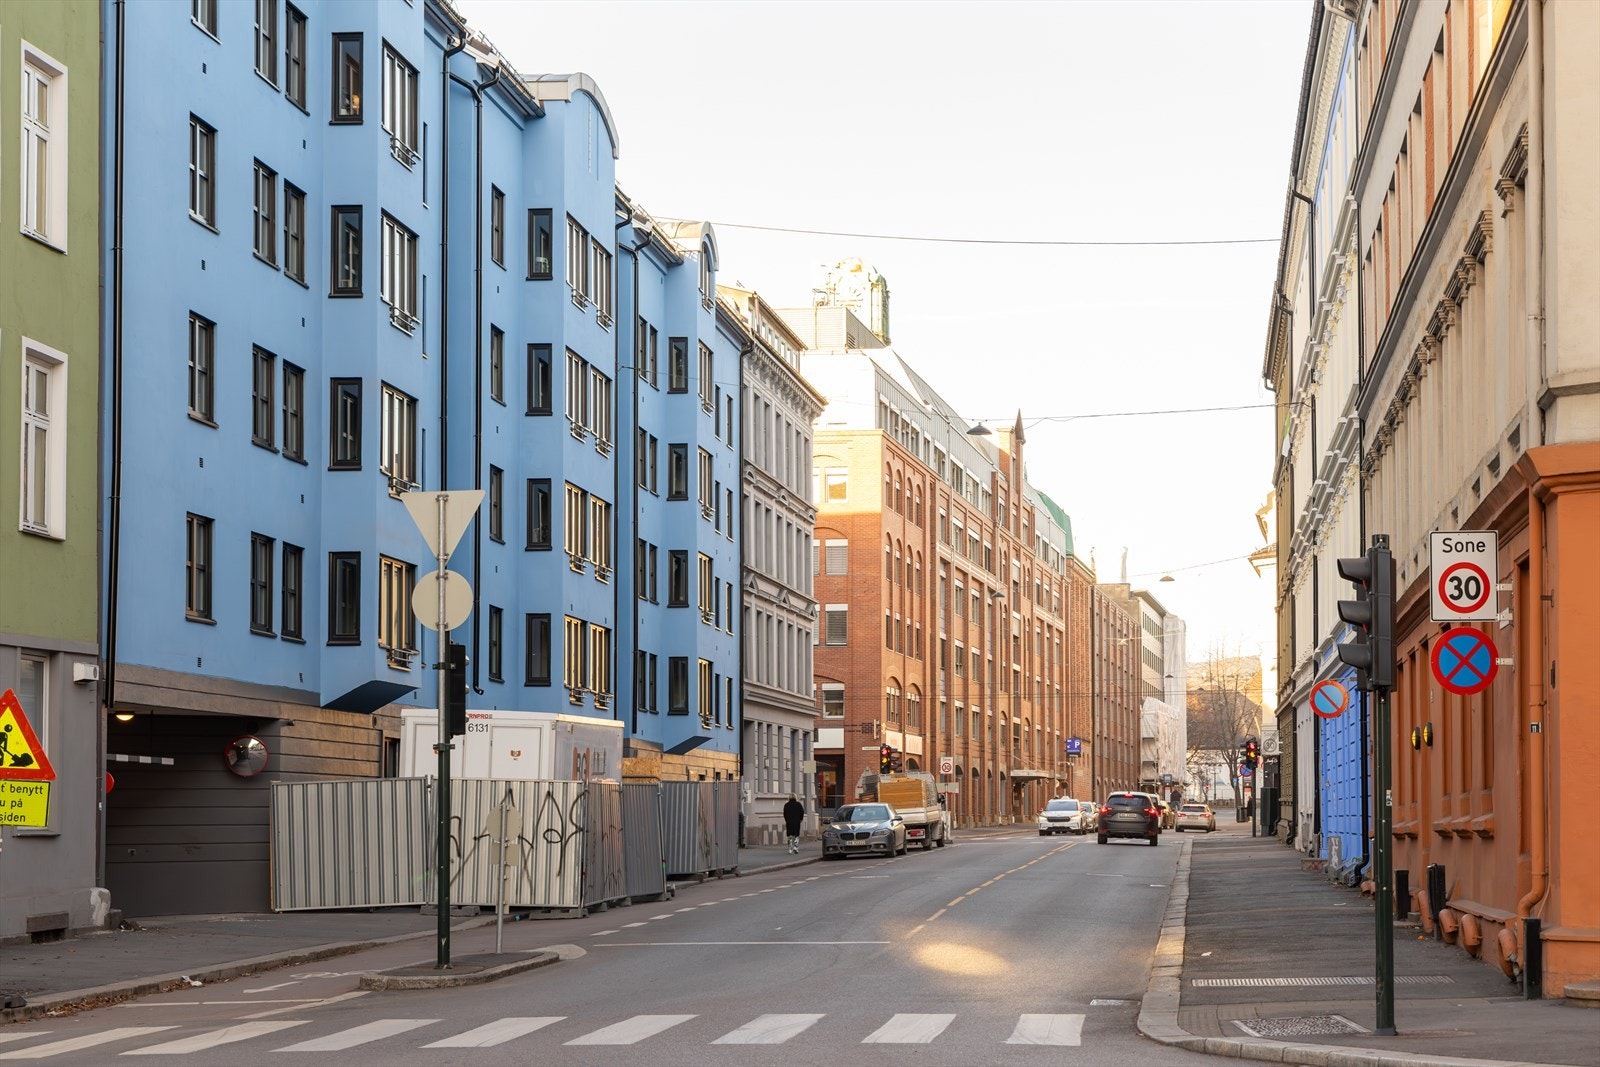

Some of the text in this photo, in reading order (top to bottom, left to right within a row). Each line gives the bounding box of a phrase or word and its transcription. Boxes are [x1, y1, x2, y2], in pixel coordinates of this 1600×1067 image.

[1442, 537, 1485, 553] Sone
[1448, 575, 1481, 600] 30
[468, 723, 488, 732] 6131
[10, 784, 43, 796] benytt
[11, 798, 23, 809] på
